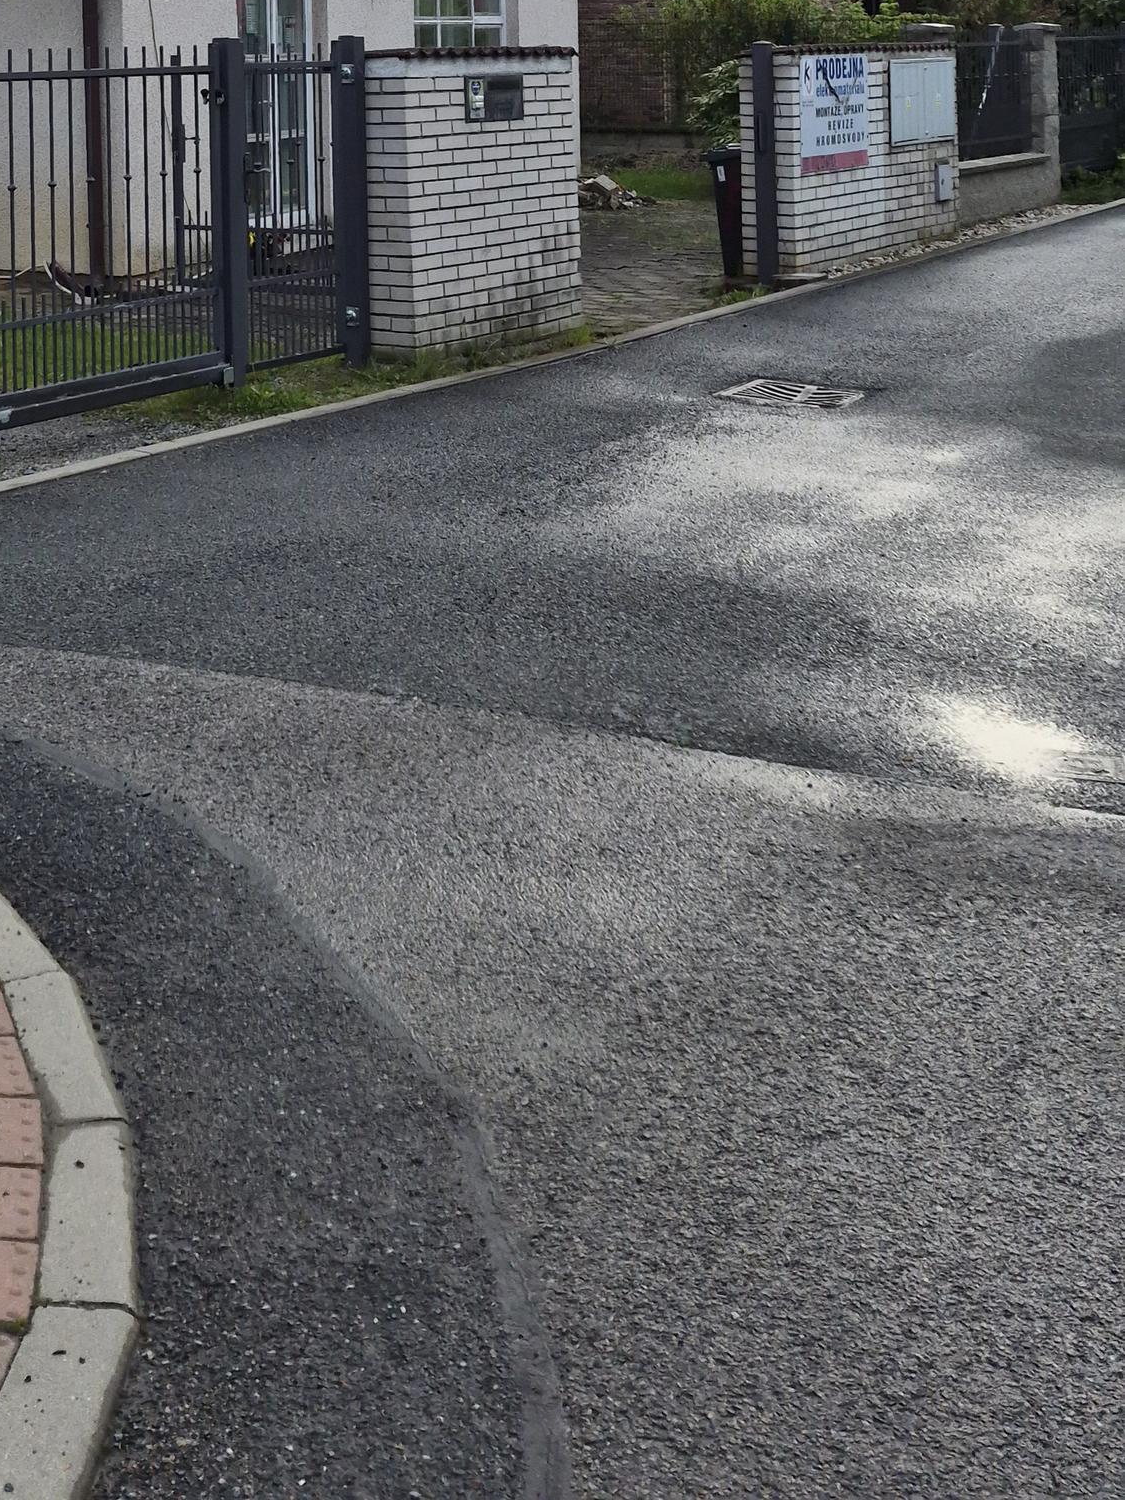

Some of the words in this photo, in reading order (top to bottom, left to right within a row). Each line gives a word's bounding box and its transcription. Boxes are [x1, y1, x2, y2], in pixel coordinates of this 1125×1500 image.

[815, 56, 865, 81] PRODEJNA
[827, 118, 854, 131] REVIZE
[815, 131, 865, 147] HROMOSVODY
